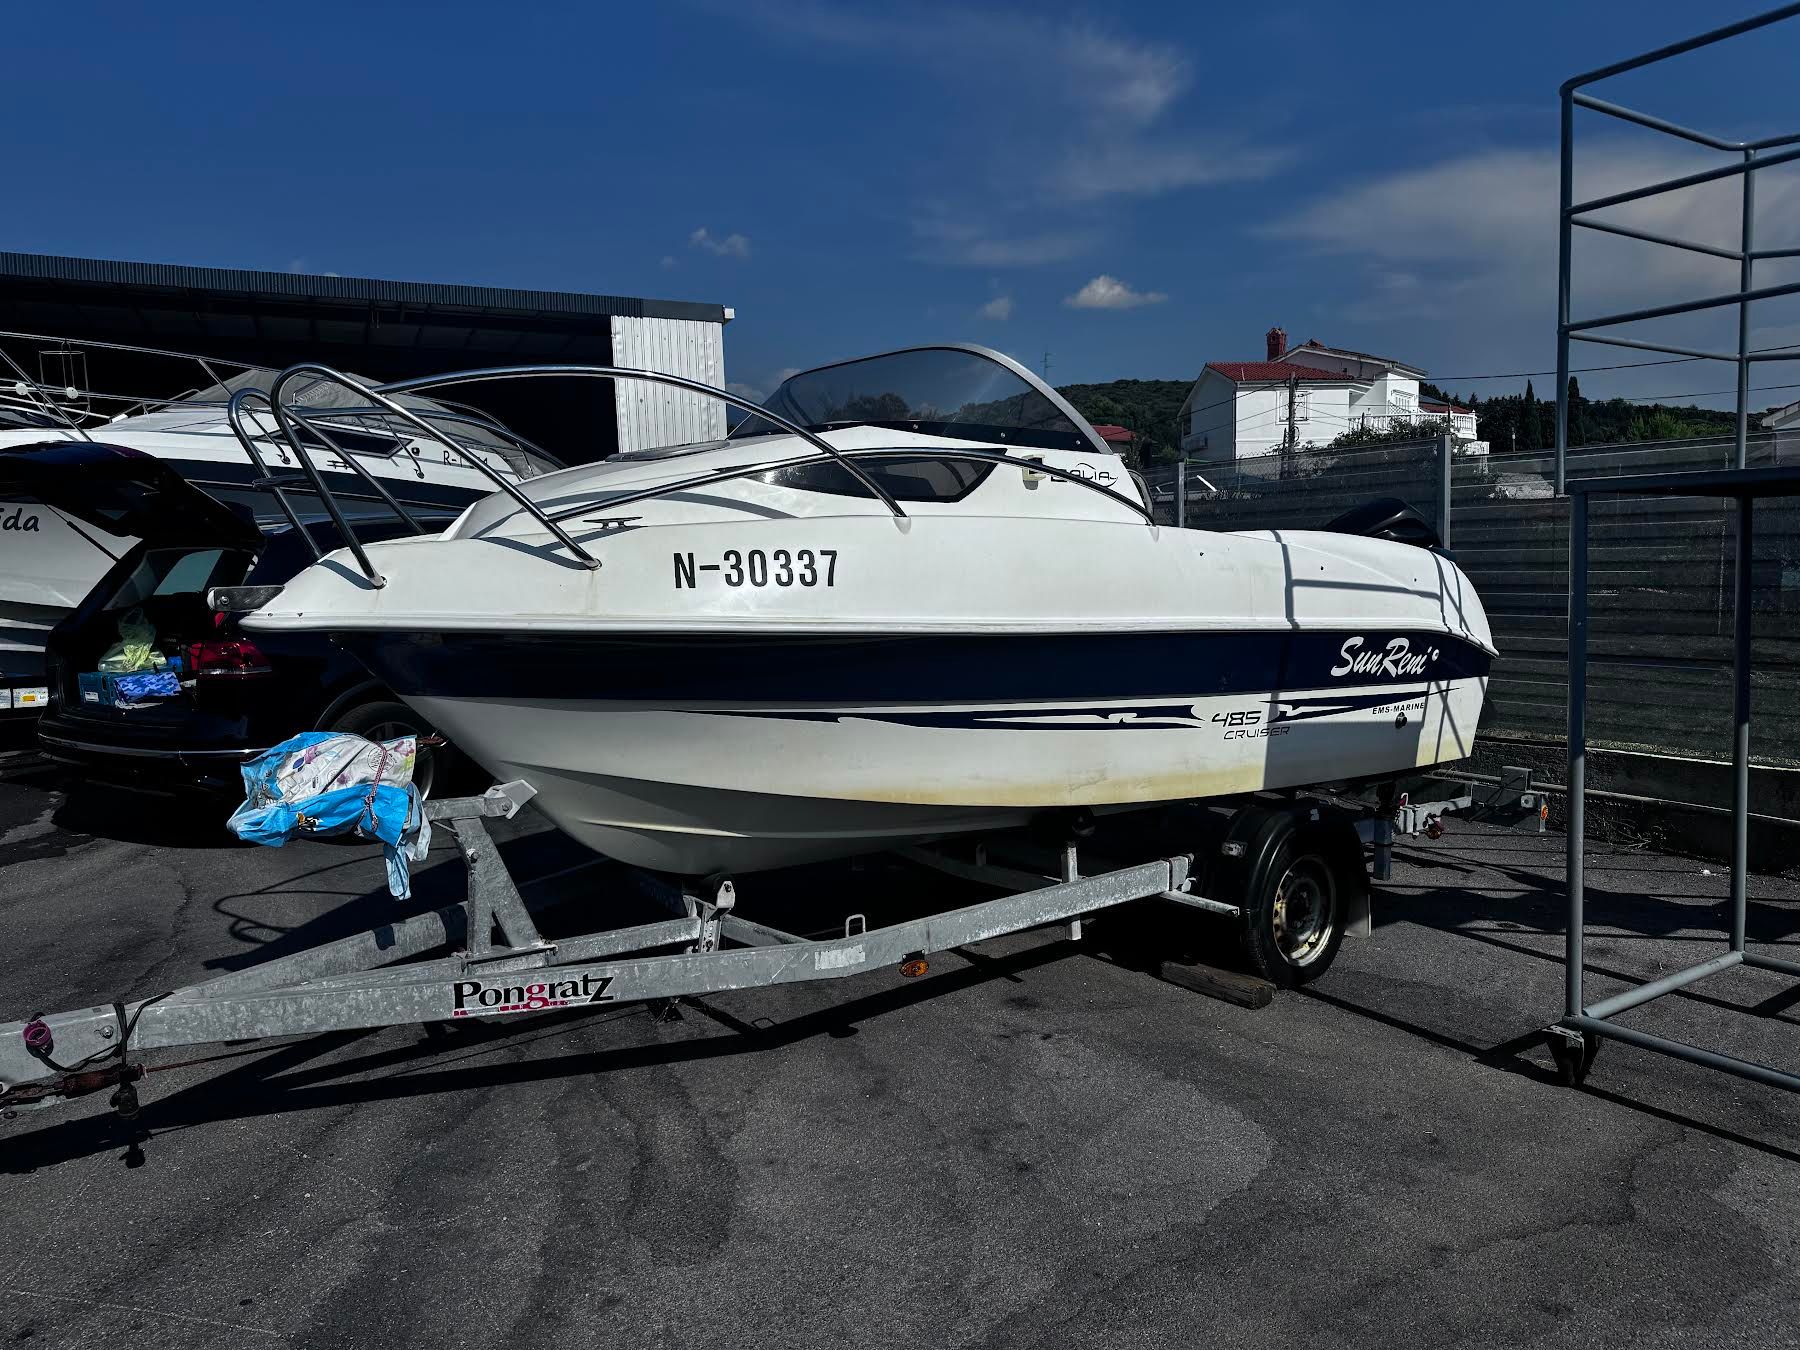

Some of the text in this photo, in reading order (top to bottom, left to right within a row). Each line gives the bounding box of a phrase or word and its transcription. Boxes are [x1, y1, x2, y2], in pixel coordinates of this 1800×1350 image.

[0, 507, 39, 532] da
[673, 549, 838, 589] N-30337
[1211, 710, 1262, 727] 485
[1372, 702, 1425, 715] EMS-MARINE
[1223, 726, 1290, 740] CRUISER
[453, 973, 614, 1010] Pongratz
